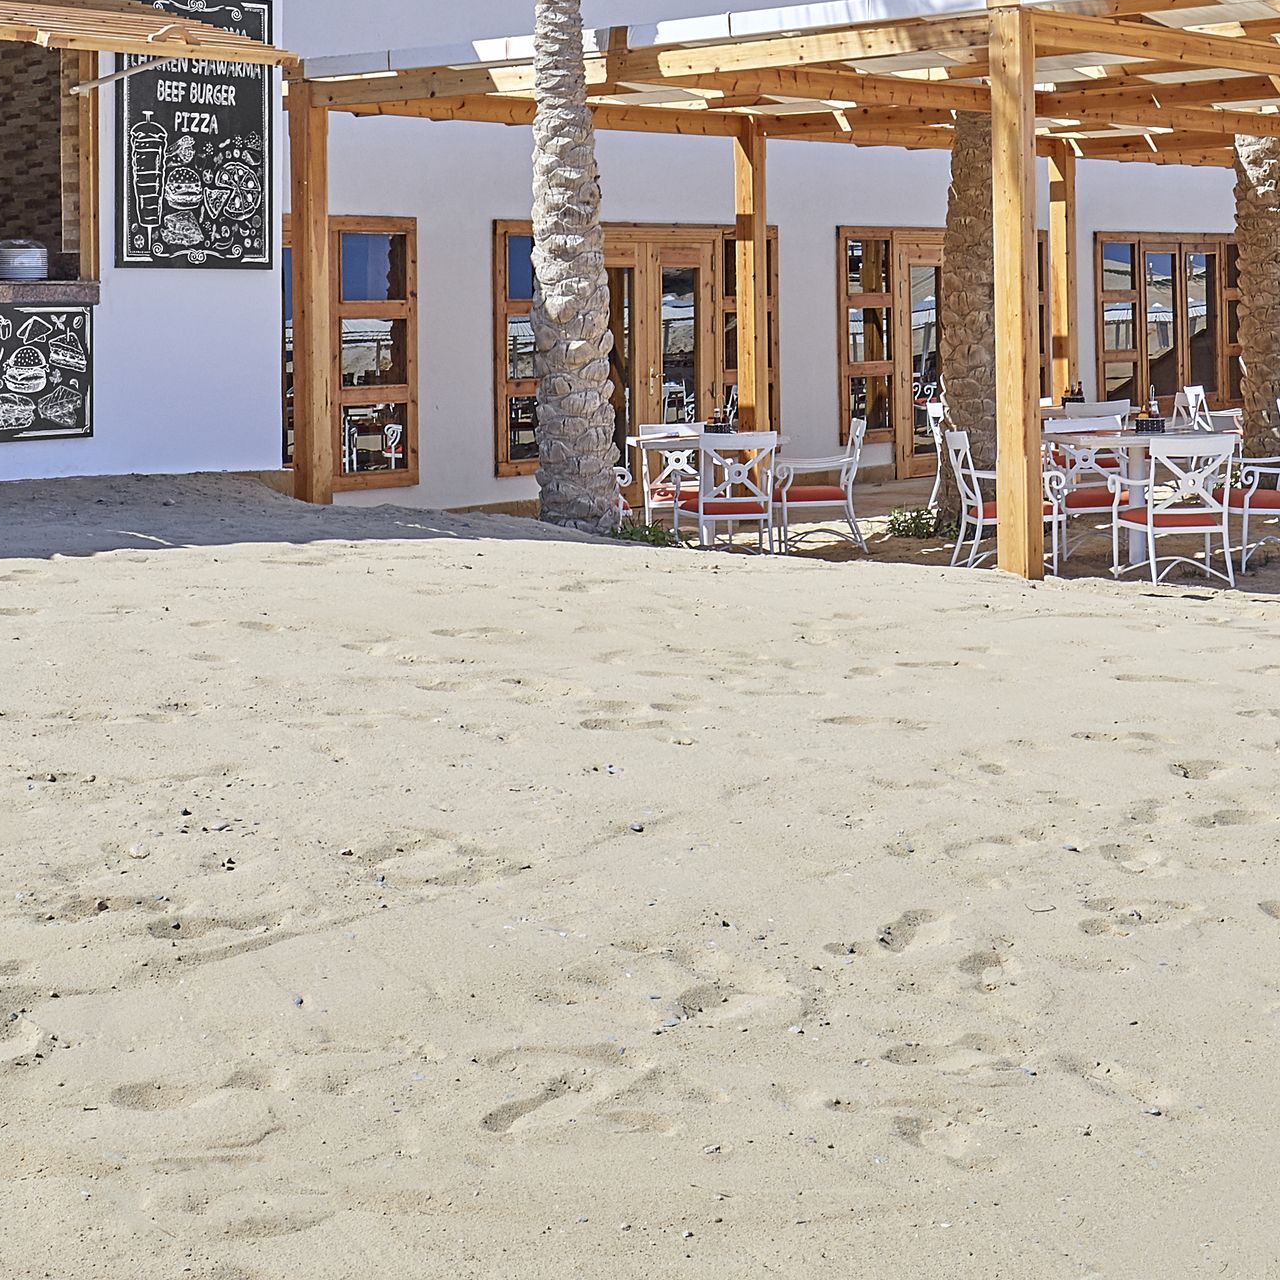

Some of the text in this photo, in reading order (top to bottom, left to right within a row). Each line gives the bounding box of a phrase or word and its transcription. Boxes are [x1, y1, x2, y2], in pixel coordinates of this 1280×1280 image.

[191, 58, 261, 79] SHAWARMA
[157, 80, 236, 106] BEEF BURGER
[174, 111, 219, 135] PIZZA
